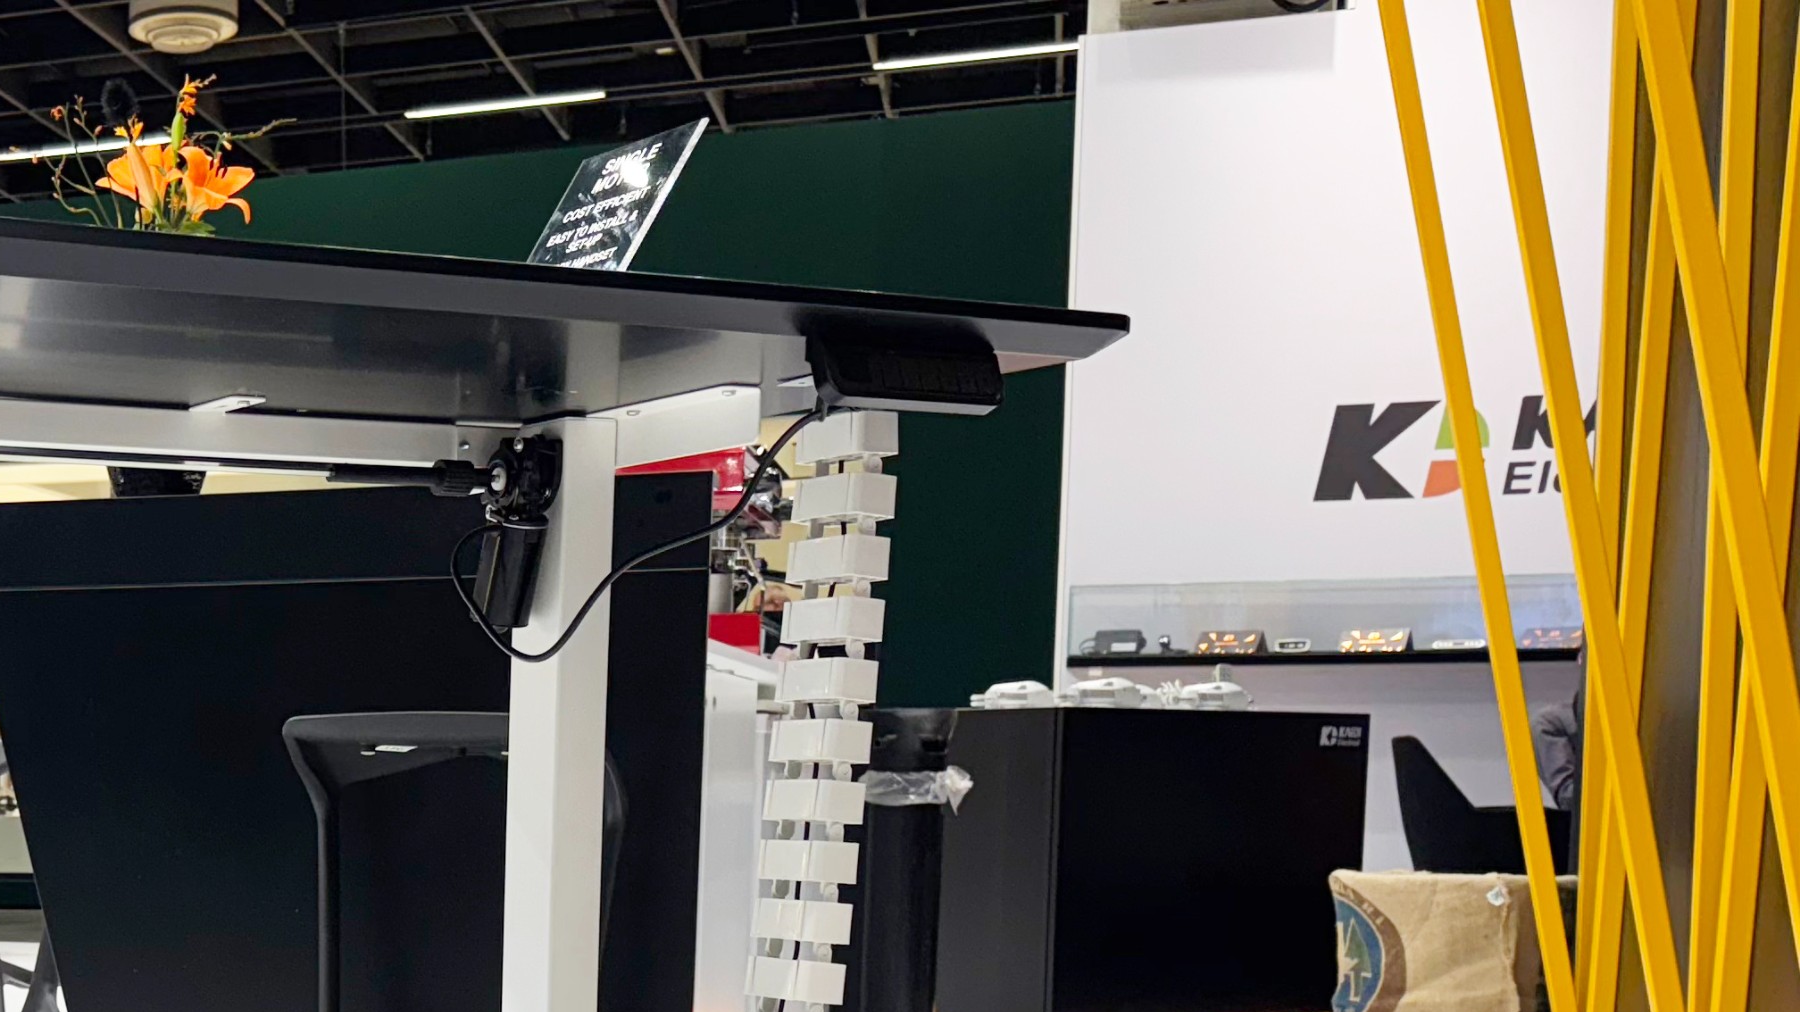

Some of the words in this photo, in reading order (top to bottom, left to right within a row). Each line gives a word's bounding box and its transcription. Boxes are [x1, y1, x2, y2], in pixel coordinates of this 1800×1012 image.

[562, 203, 595, 224] COST
[594, 186, 651, 213] EFFICIENT
[546, 229, 576, 248] EASY
[574, 225, 589, 238] TO
[588, 213, 630, 235] INSTALL
